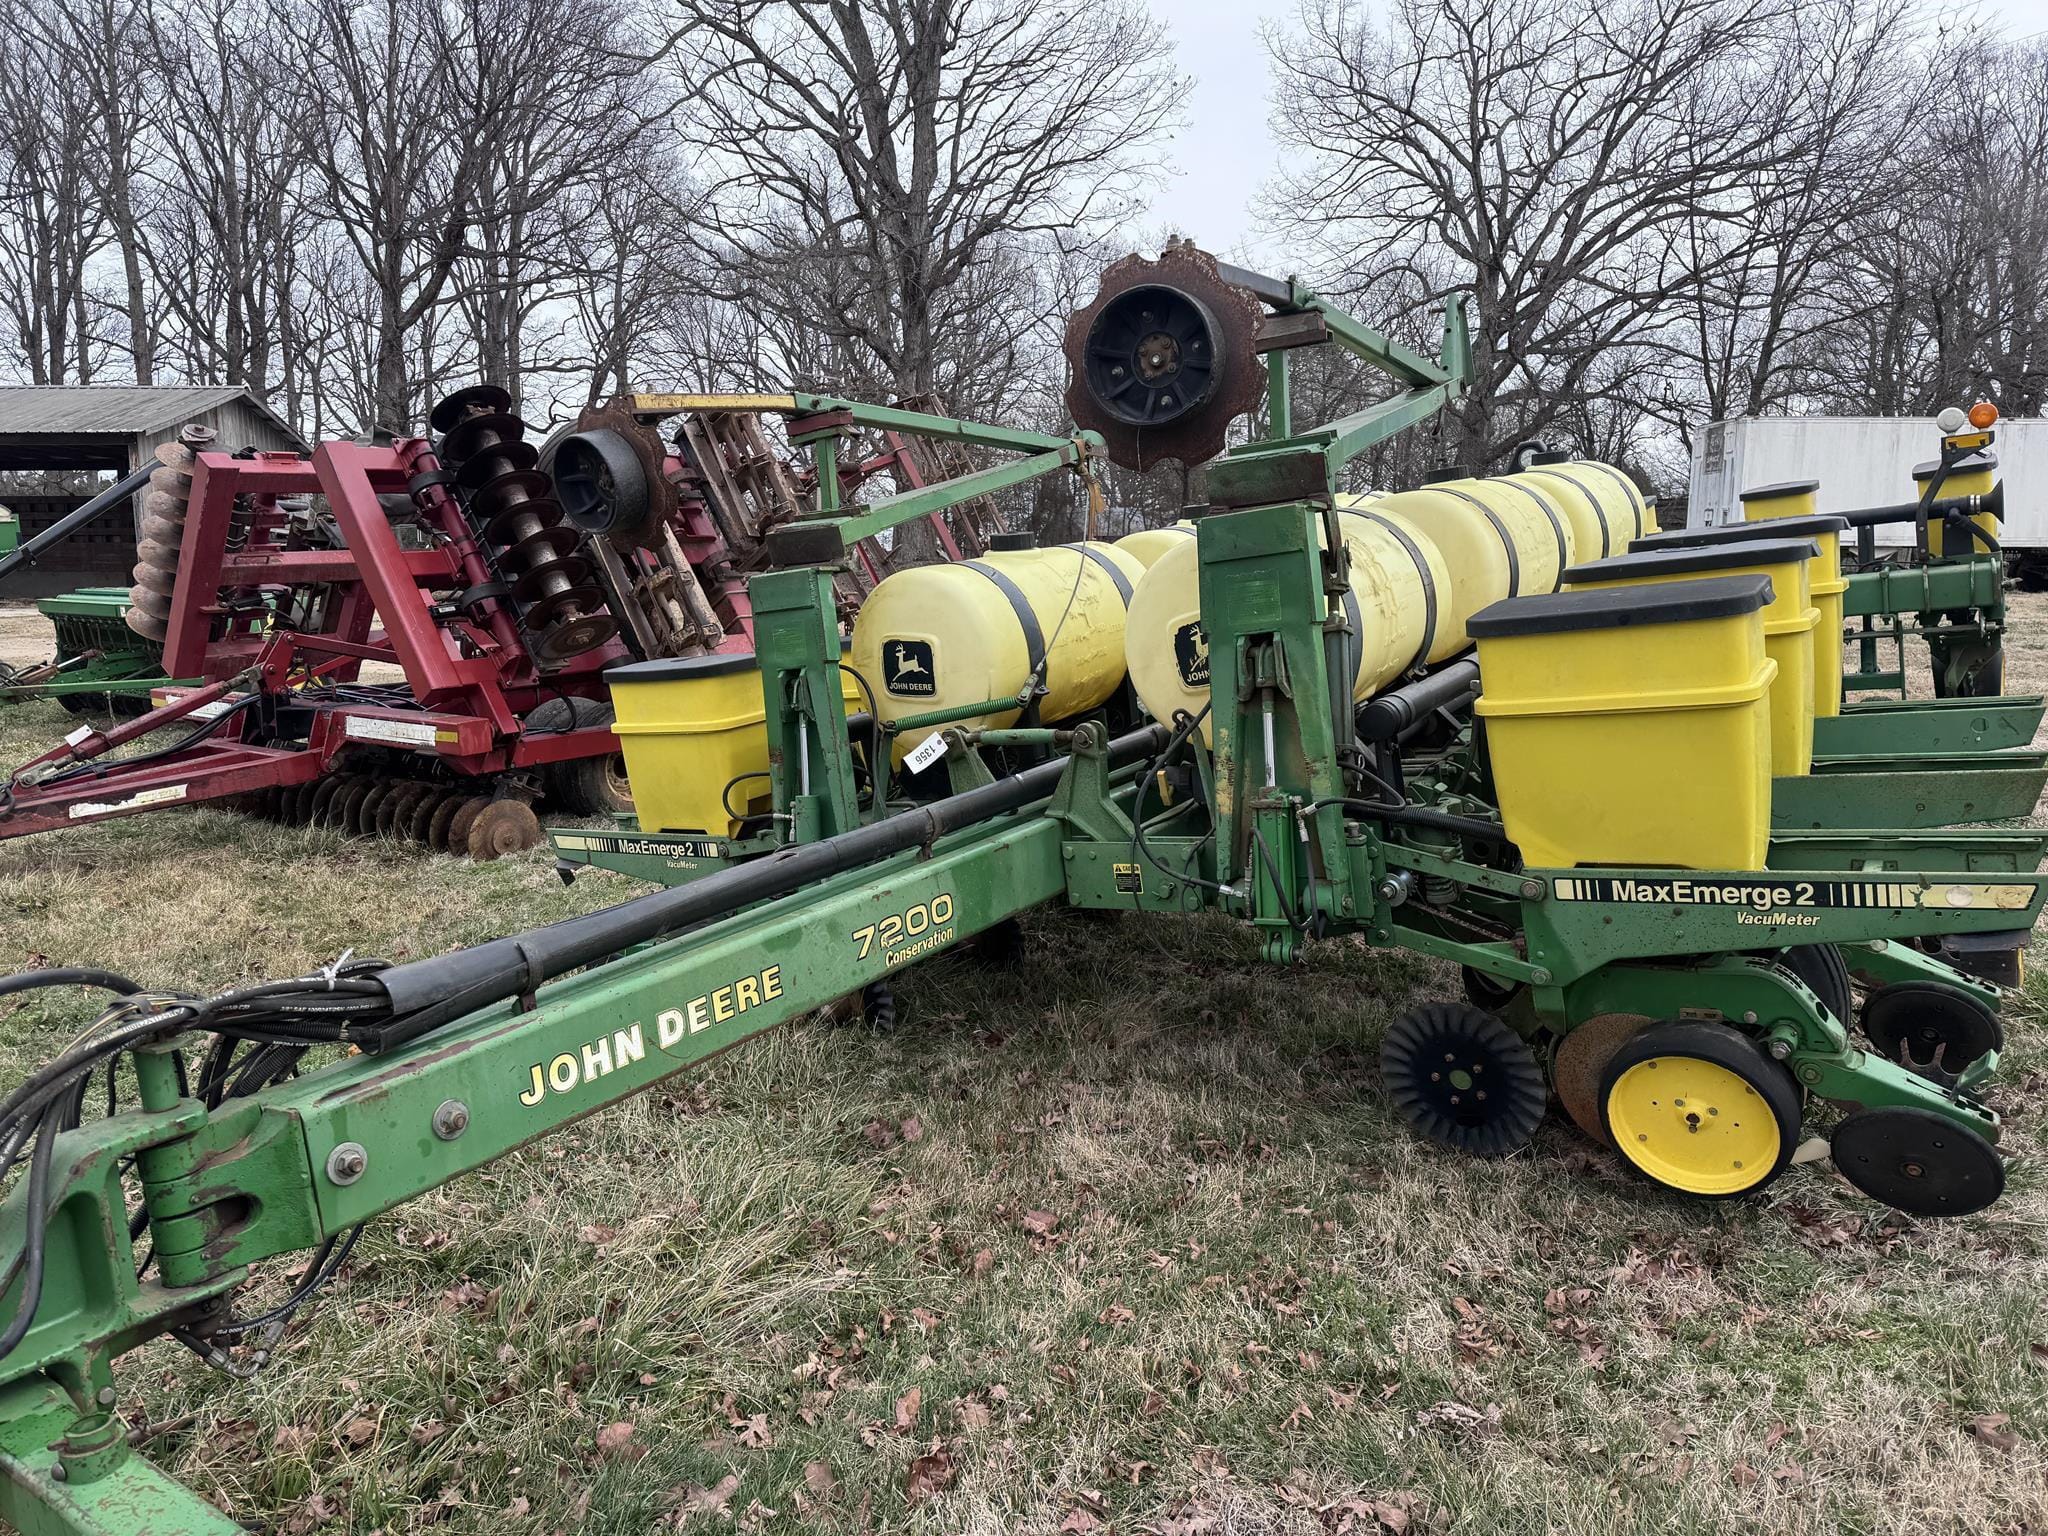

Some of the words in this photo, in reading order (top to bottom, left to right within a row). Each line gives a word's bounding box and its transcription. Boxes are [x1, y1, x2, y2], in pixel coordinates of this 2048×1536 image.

[889, 682, 908, 690] JOHN
[909, 683, 933, 691] DEERE
[915, 744, 936, 765] 1356
[617, 839, 685, 859] MaxEmerge
[686, 842, 695, 857] 2
[666, 859, 698, 870] VacuMeter
[1611, 880, 1792, 911] MaxEmerge
[1795, 883, 1816, 906] 2
[852, 893, 954, 961] 7200
[1736, 912, 1820, 926] VacuMeter
[884, 927, 954, 969] Conservation
[518, 1021, 645, 1108] JOHN
[656, 964, 784, 1050] DEERE
